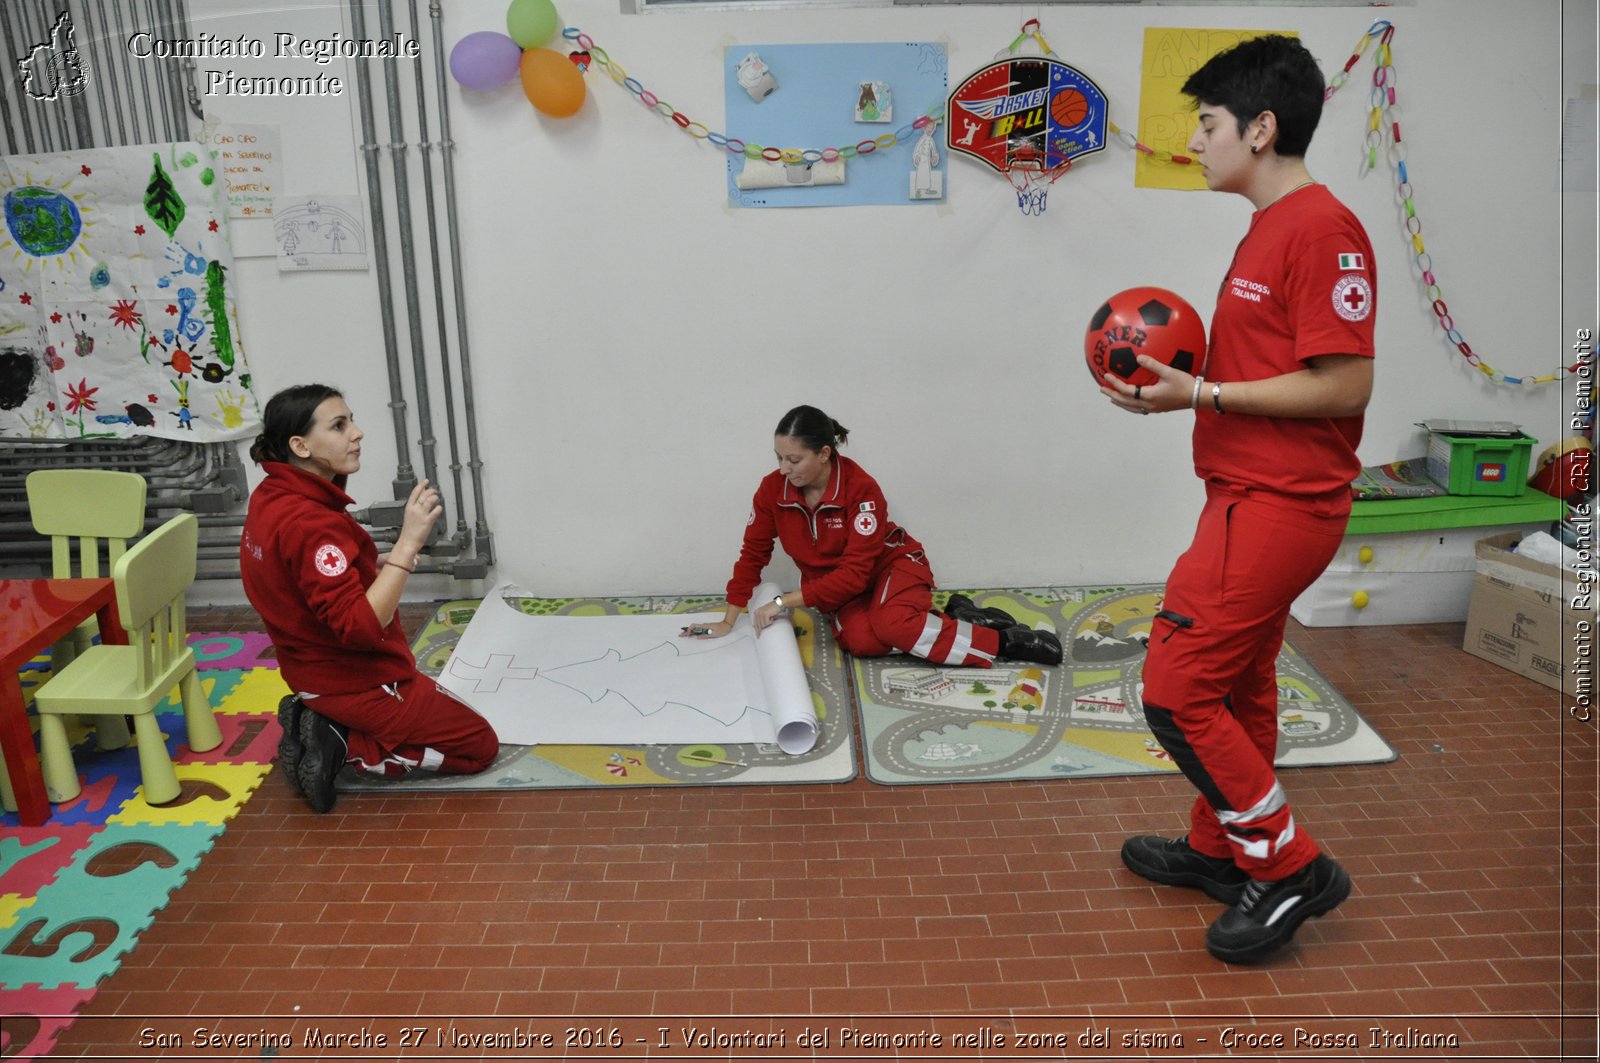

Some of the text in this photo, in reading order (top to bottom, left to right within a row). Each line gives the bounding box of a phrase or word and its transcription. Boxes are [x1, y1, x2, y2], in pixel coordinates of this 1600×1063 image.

[994, 88, 1049, 116] BASKET
[1231, 287, 1261, 303] ITALIANA
[1093, 325, 1148, 380] CORNER
[1482, 468, 1500, 476] LEGO
[1531, 656, 1567, 676] FRAGILE
